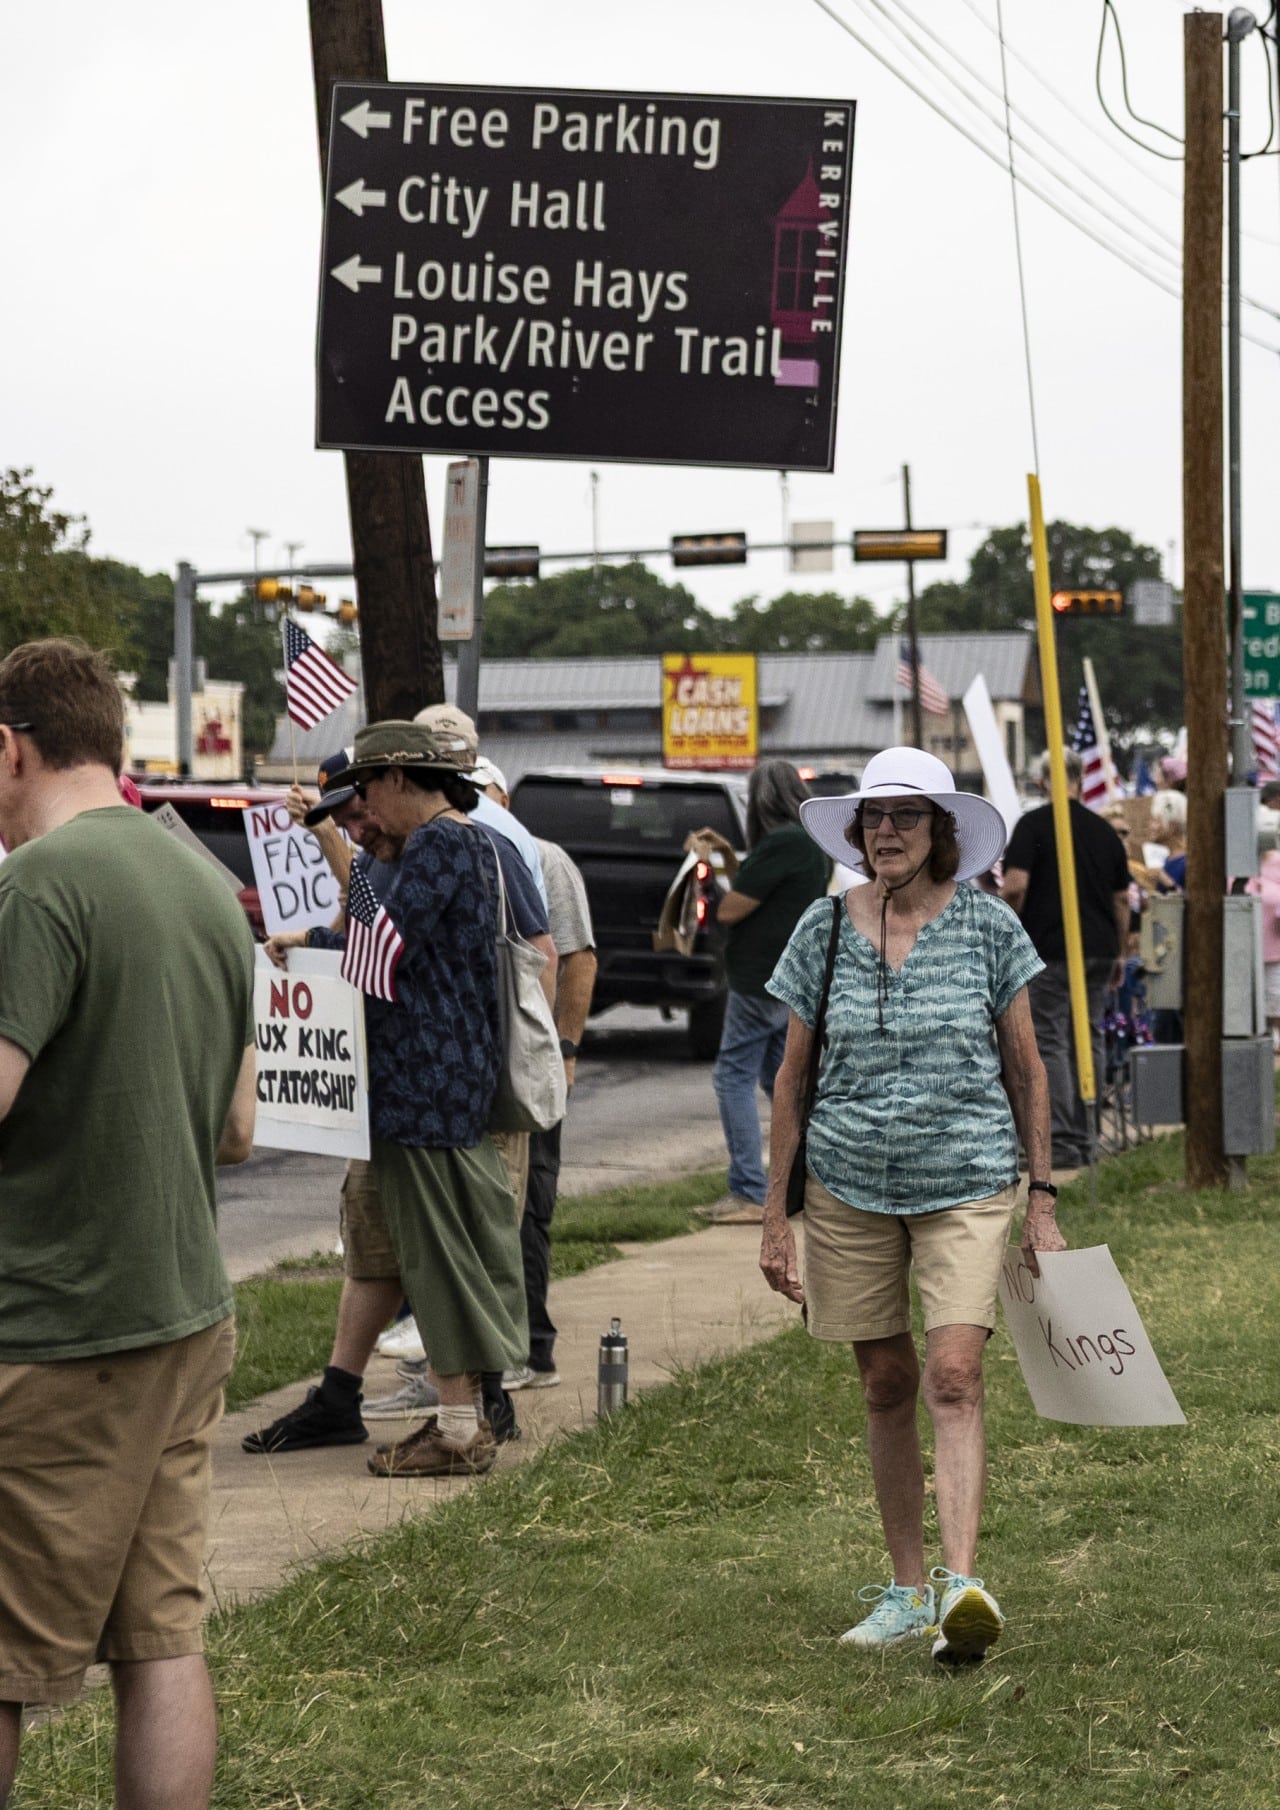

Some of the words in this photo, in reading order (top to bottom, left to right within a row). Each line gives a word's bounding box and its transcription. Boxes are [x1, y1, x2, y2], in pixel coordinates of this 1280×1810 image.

[402, 98, 509, 149] Free
[531, 103, 722, 170] Parking
[397, 173, 489, 239] City
[509, 180, 607, 232] Hall
[811, 110, 846, 333] KERRVILLE
[393, 252, 550, 305] Louise
[573, 260, 689, 323] Hays
[390, 314, 653, 373] Park/River
[674, 326, 783, 378] Trail
[384, 376, 550, 431] Access
[675, 676, 742, 707] CASH
[1243, 669, 1269, 690] an
[669, 706, 751, 736] LOANS
[251, 805, 294, 839] NO
[263, 833, 325, 879] FAS
[272, 871, 333, 921] DIC
[269, 978, 313, 1020] NO
[256, 1023, 288, 1053] UX
[298, 1026, 352, 1062] KING
[256, 1068, 357, 1113] CTATORSHIP
[1002, 1261, 1035, 1304] NO
[1038, 1315, 1136, 1376] Kings
